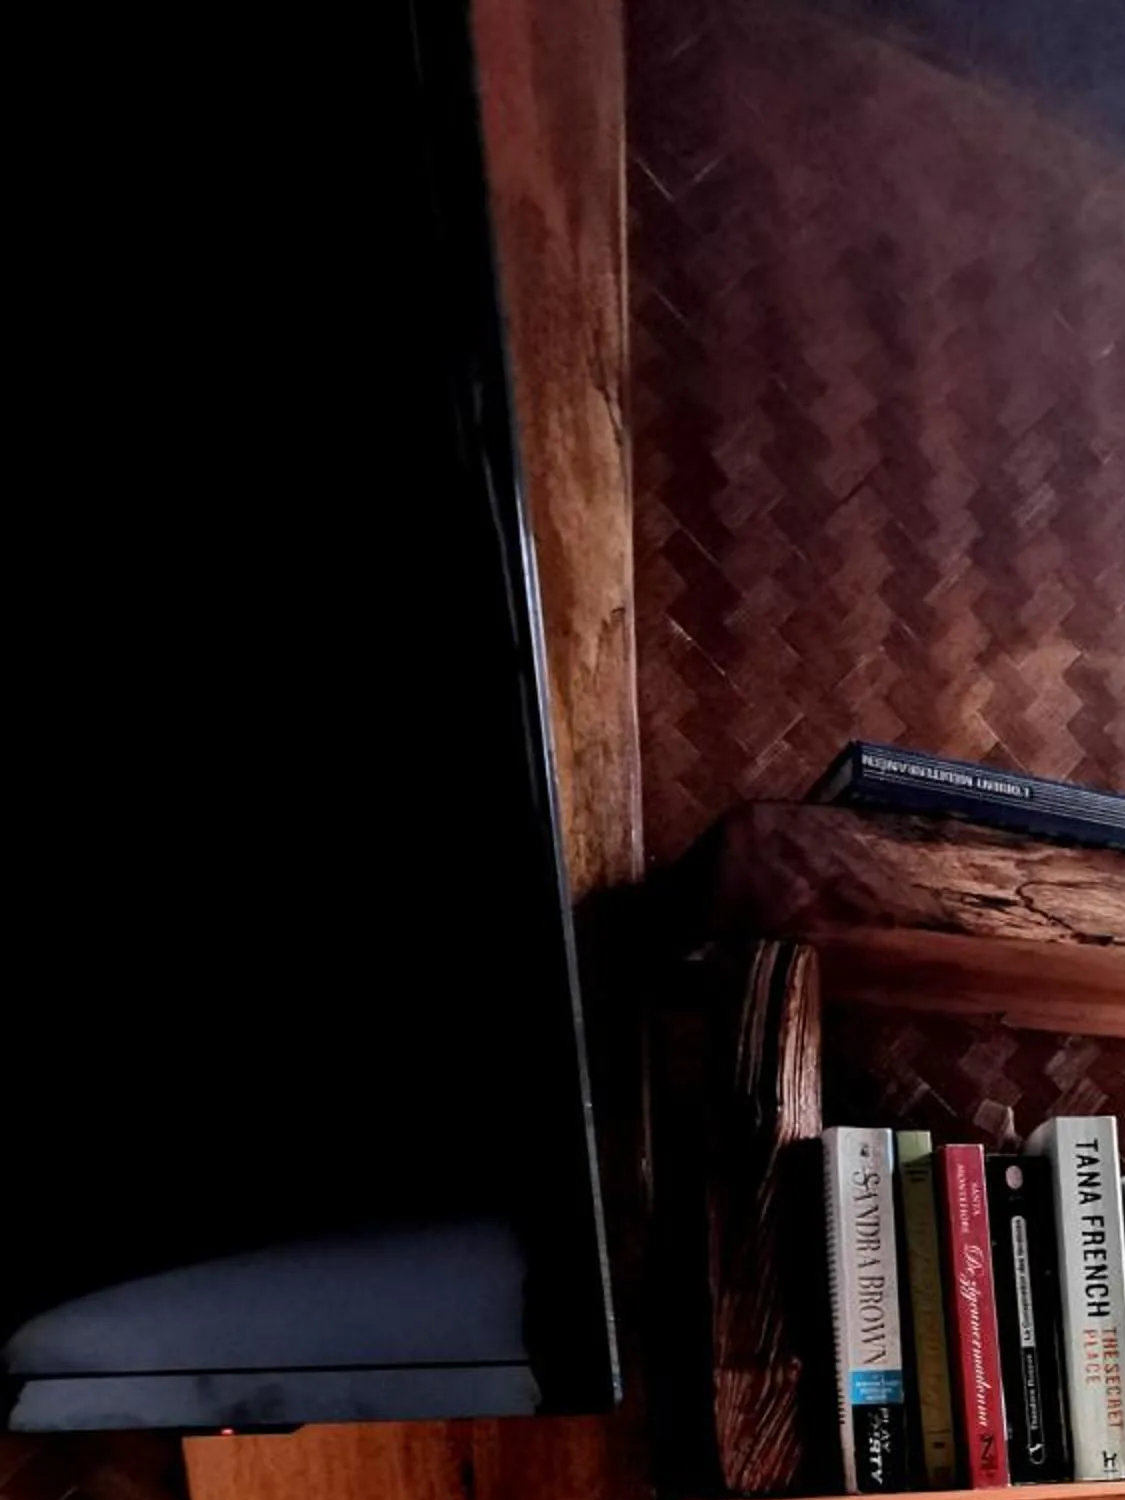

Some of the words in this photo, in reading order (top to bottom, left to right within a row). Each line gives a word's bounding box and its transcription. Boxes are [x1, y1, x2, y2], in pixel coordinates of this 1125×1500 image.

[971, 1182, 981, 1217] SANTA
[1075, 1138, 1099, 1205] TANA
[852, 1168, 882, 1269] SANDRA
[963, 1243, 986, 1274] De
[1081, 1214, 1110, 1318] FRENCH
[859, 1275, 888, 1366] BROWN
[1100, 1327, 1118, 1361] THE
[1083, 1328, 1099, 1386] PLACE
[1103, 1364, 1124, 1431] SECRET
